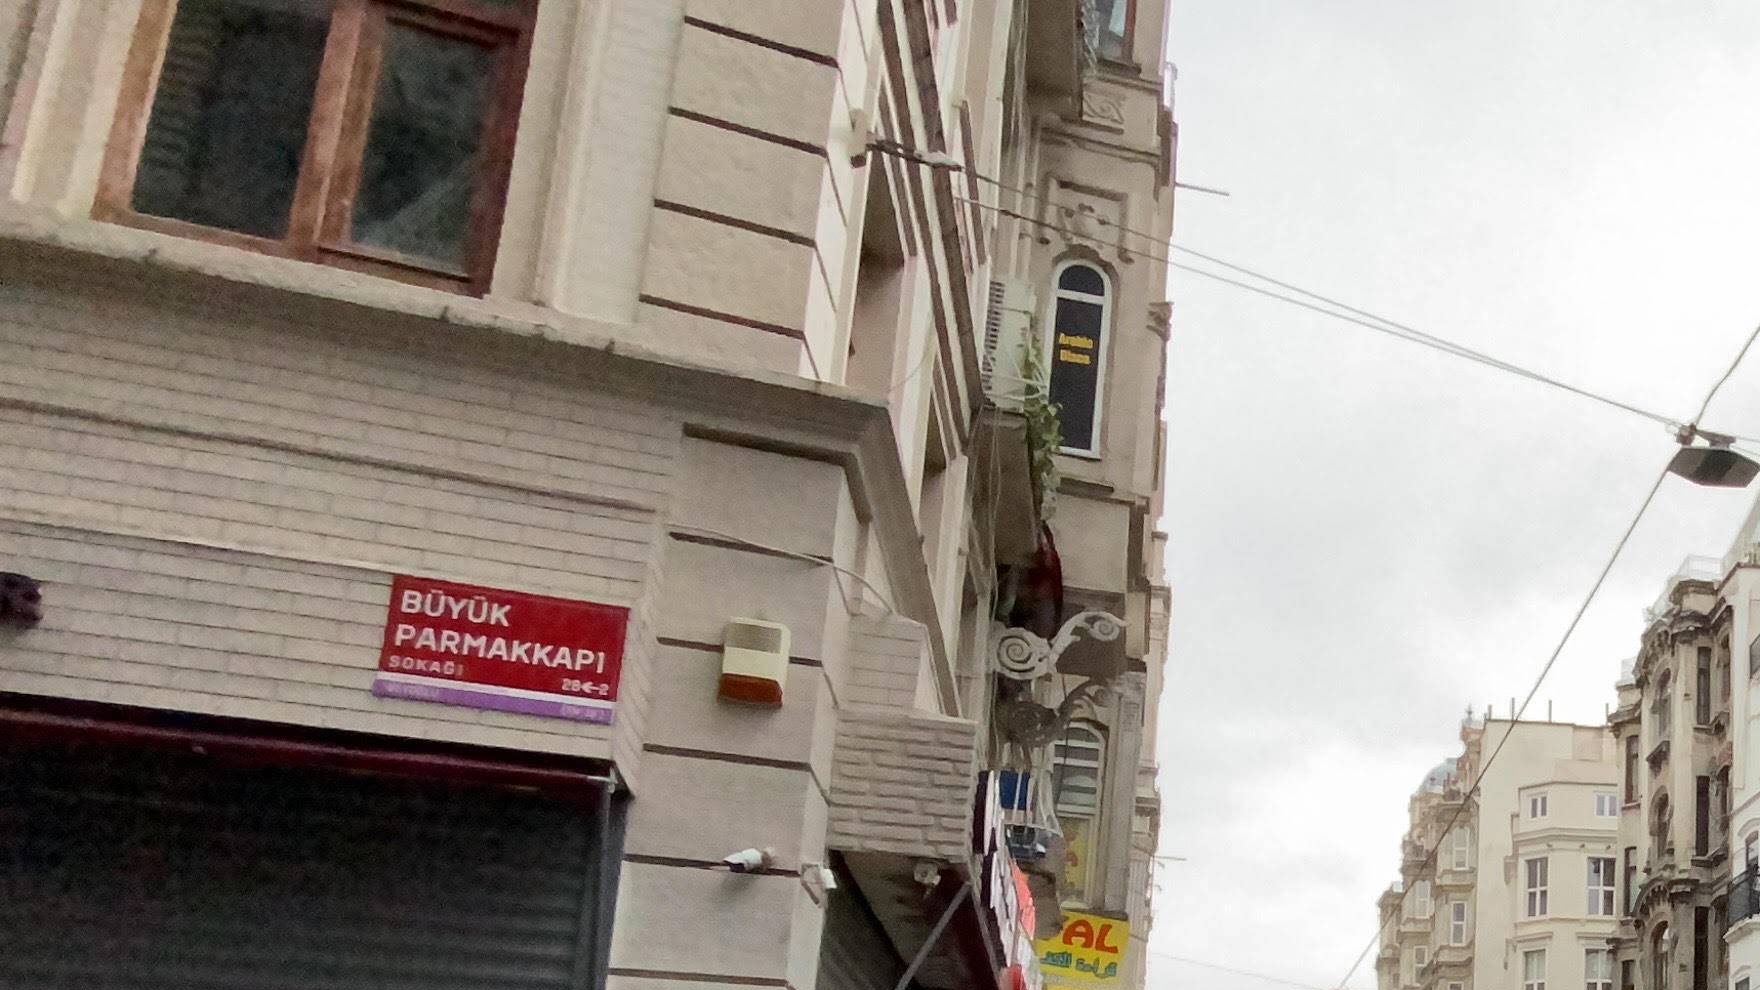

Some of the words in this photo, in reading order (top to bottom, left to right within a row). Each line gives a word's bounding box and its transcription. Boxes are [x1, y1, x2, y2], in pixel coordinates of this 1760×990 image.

[401, 589, 512, 627] BÜYÜK
[395, 624, 605, 674] PARMAKKAPI
[1062, 919, 1118, 954] AL
